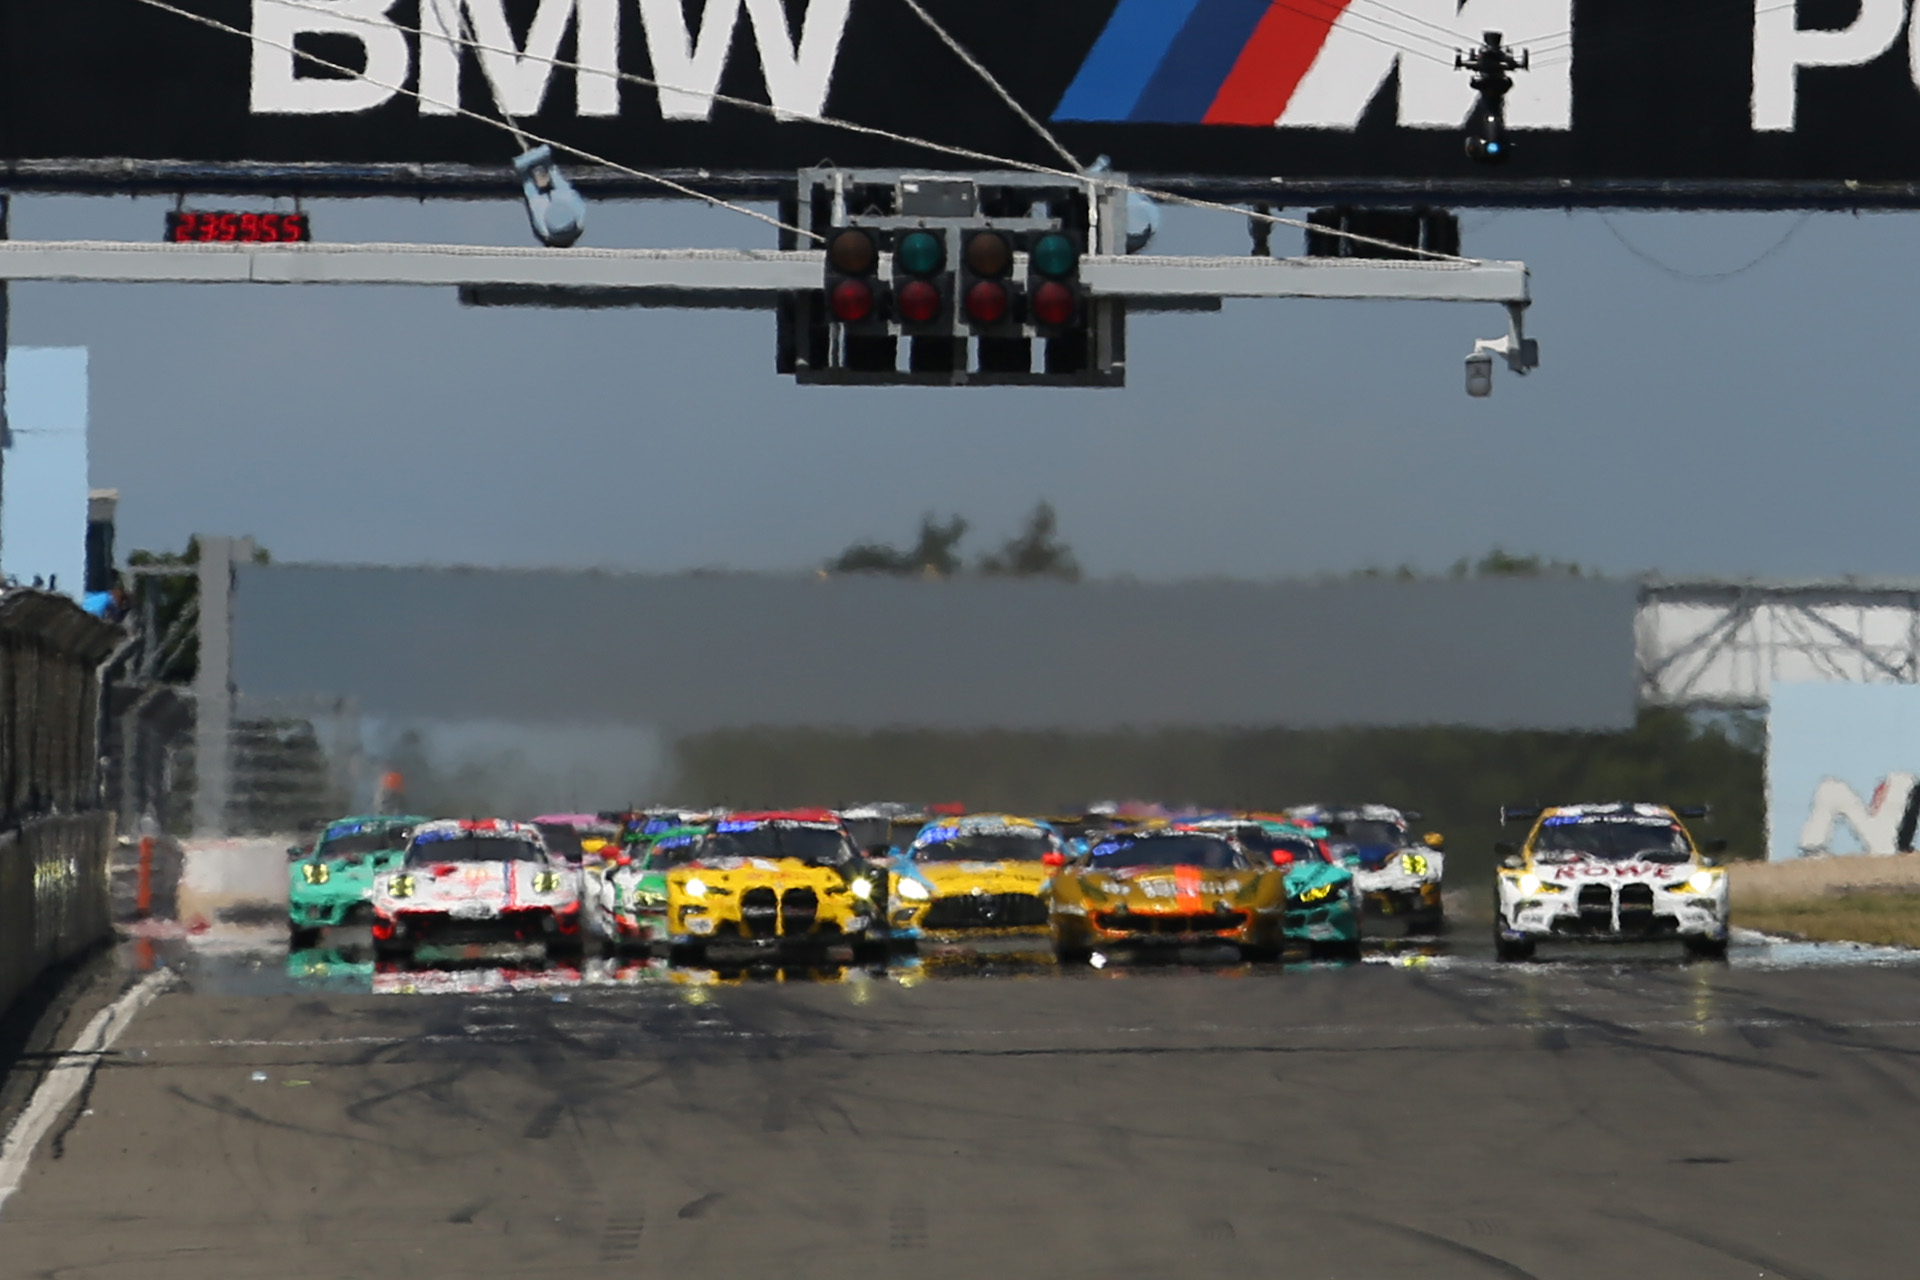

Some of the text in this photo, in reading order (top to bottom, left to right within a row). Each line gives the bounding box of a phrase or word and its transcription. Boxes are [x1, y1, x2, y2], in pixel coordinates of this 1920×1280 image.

[250, 0, 853, 121] BMW
[1752, 0, 1920, 133] P
[1553, 864, 1675, 880] ROWE
